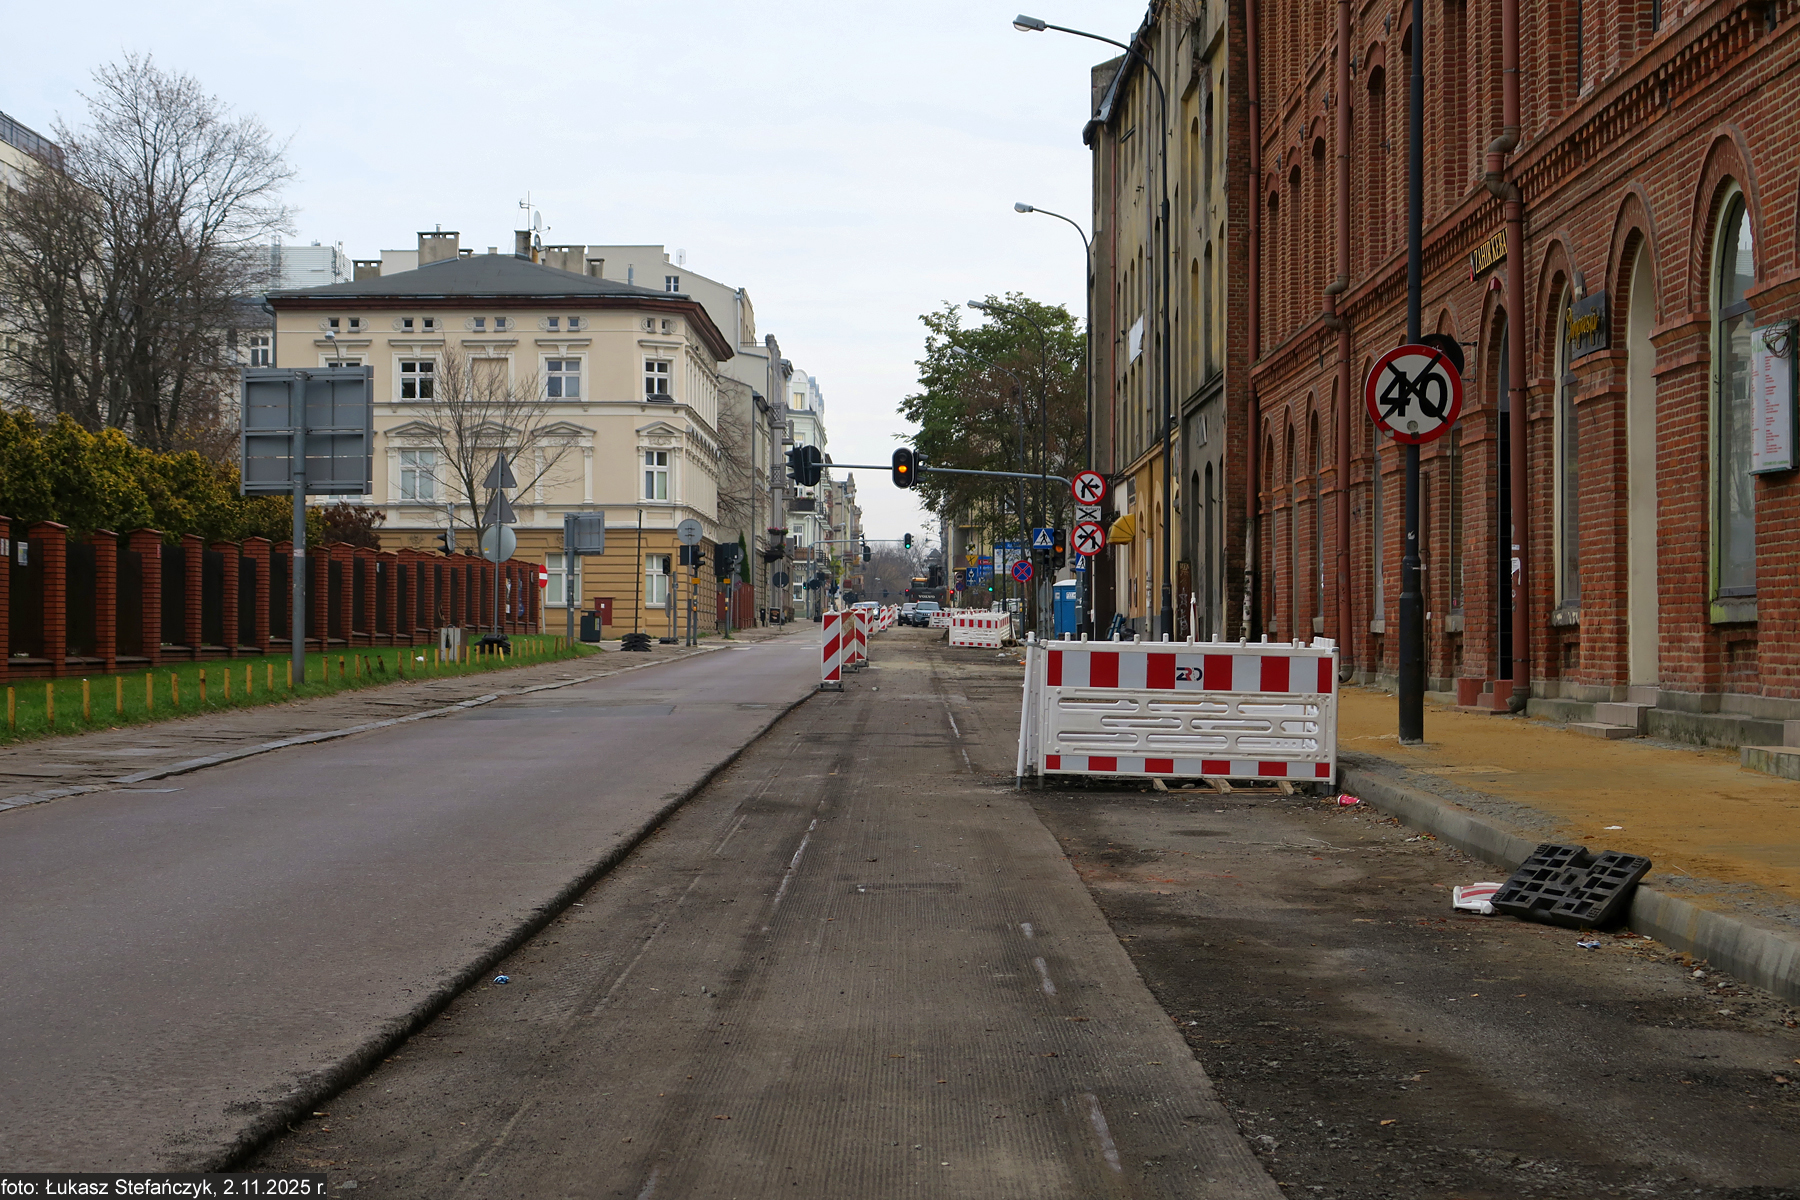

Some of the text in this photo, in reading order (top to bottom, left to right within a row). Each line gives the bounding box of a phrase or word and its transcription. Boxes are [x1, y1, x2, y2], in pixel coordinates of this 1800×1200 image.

[1474, 228, 1507, 274] ZAHIR KEBA
[1380, 371, 1447, 418] 40
